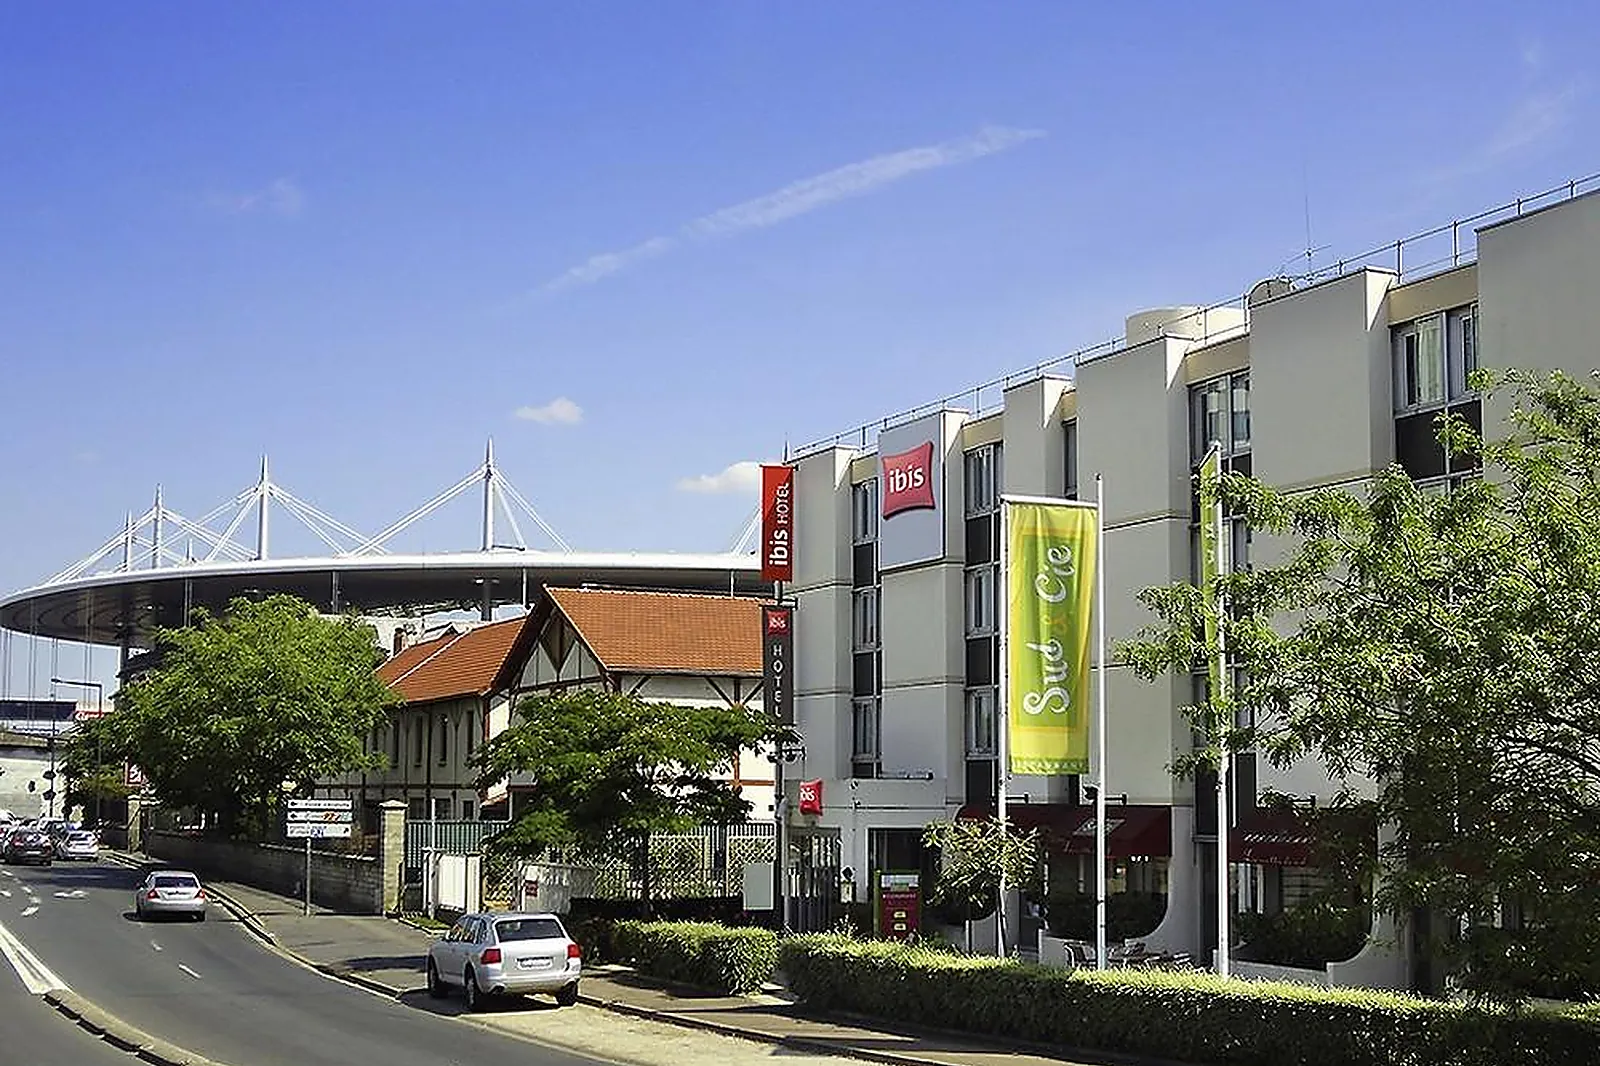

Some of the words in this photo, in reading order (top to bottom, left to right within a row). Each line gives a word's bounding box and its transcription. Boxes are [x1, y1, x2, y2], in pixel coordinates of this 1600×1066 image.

[775, 483, 789, 524] HOTEL
[889, 465, 925, 493] ibis
[769, 529, 789, 566] ibis
[1034, 544, 1076, 603] Cie
[772, 644, 784, 718] HOTEL
[1023, 638, 1070, 716] Sud
